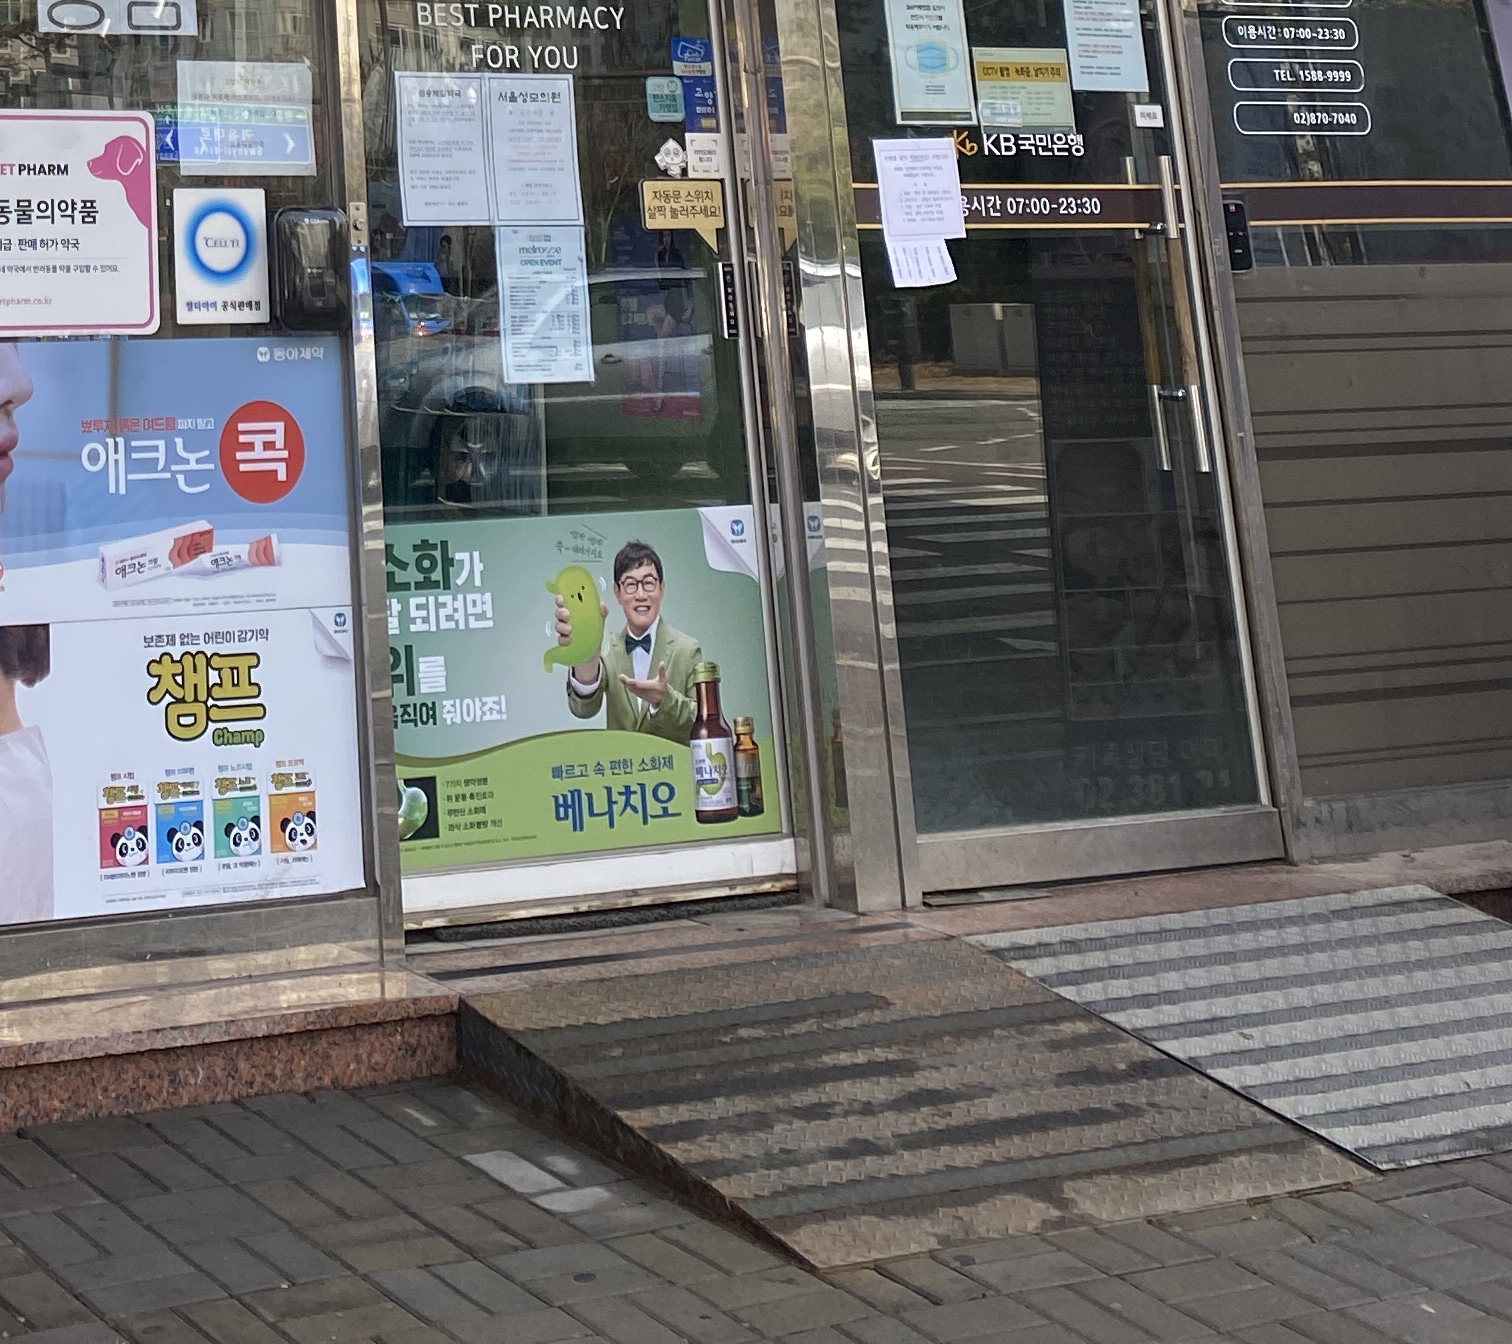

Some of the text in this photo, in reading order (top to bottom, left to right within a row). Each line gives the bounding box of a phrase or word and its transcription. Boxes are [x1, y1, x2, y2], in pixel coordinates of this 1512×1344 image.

[417, 2, 625, 30] BEST PHARMACY
[470, 44, 579, 70] FOR YOU
[1298, 69, 1352, 82] 1588-9999
[497, 89, 562, 105] 서울성모의원
[982, 132, 1085, 157] KB국민은행
[18, 164, 69, 177] PHARM
[652, 189, 714, 204] 자동문 스위치
[1006, 196, 1102, 216] 07:00-23:30
[646, 204, 722, 221] 살짝 눌러주세요!
[39, 238, 59, 252] 허가
[60, 238, 81, 252] 약국
[272, 346, 325, 362] 동아제약
[80, 421, 290, 495] 애크논 콕
[409, 592, 495, 633] 되려면
[146, 649, 267, 743] 챔프
[441, 694, 508, 725] 줘야죠!
[211, 727, 266, 749] Champ
[551, 754, 674, 782] 빠르고 속 편한 소화제
[551, 781, 683, 833] 베나치오
